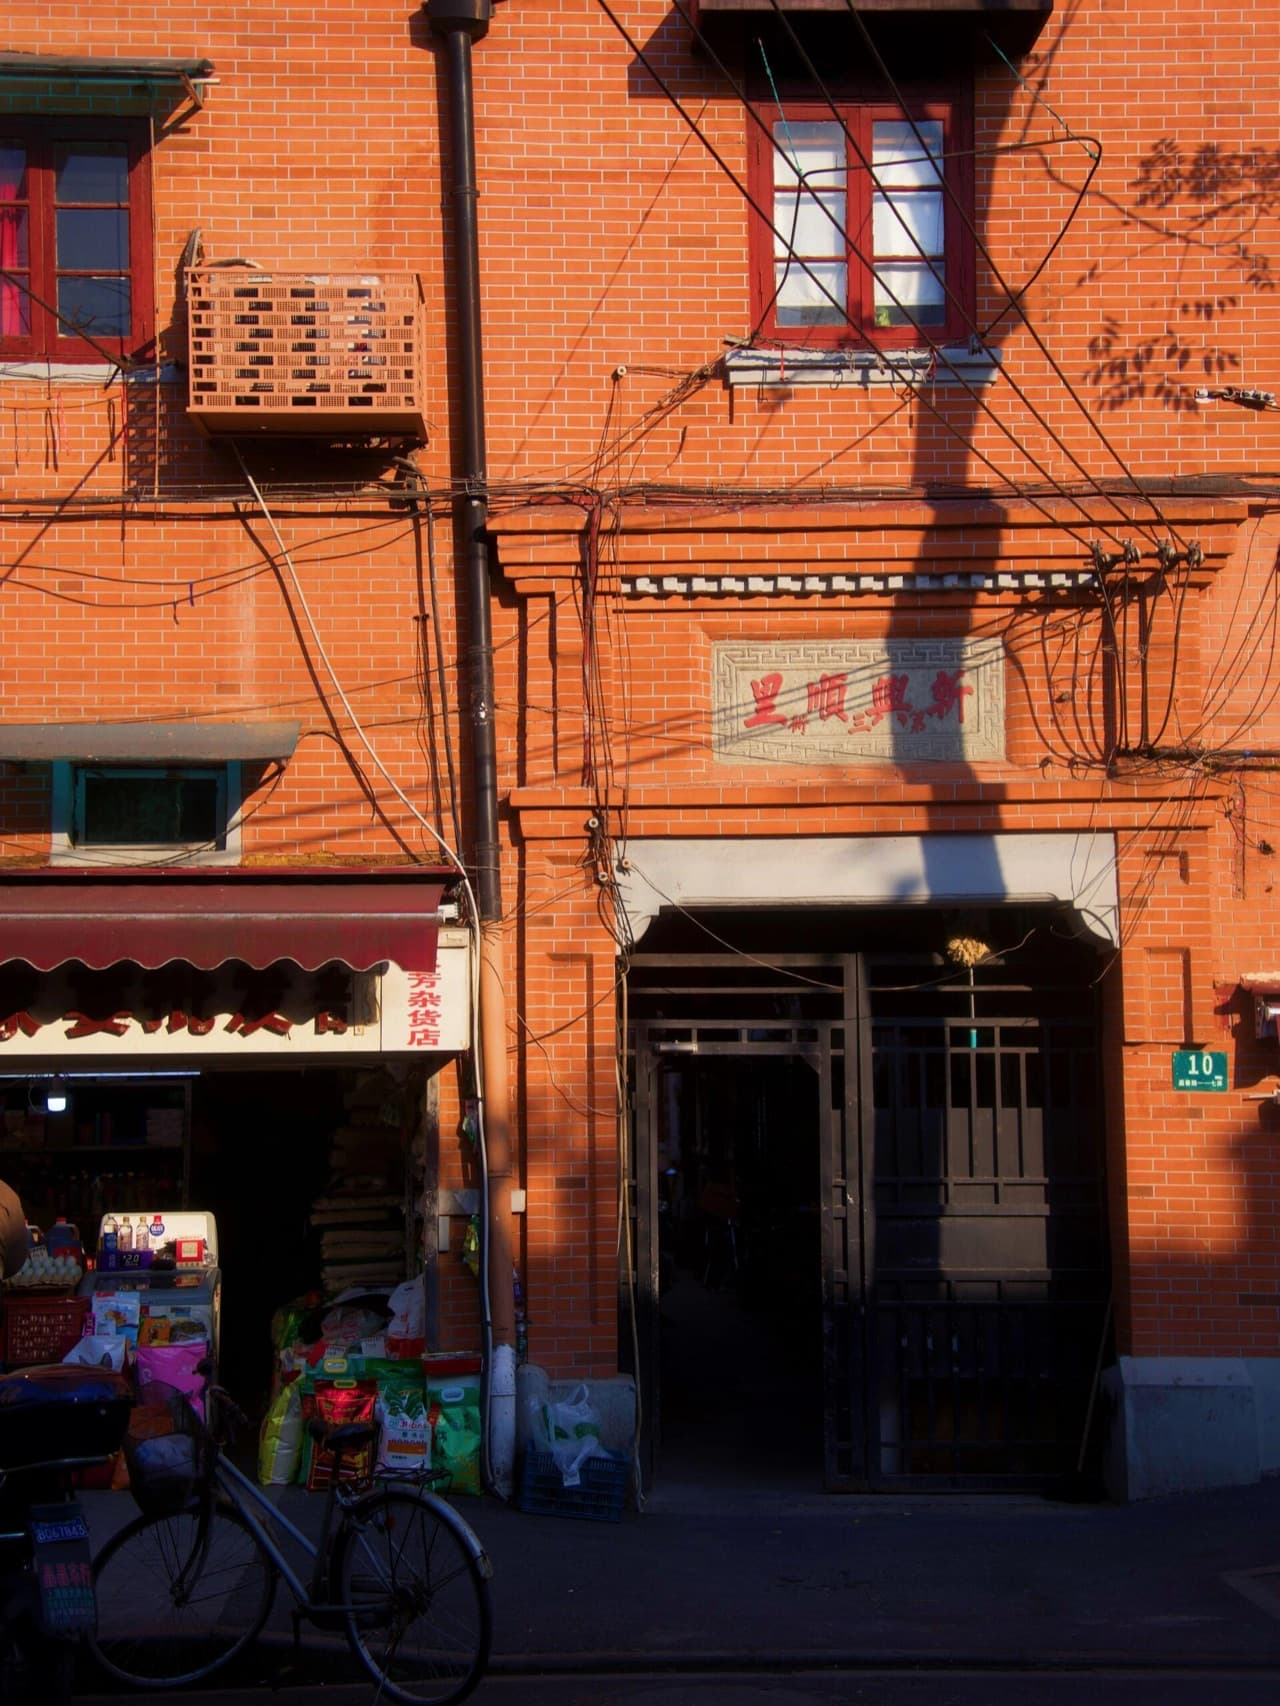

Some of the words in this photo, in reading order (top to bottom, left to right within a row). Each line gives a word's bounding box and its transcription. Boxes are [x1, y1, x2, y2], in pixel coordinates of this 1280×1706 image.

[408, 964, 442, 1046] 芳杂货店
[1188, 1054, 1213, 1076] 10
